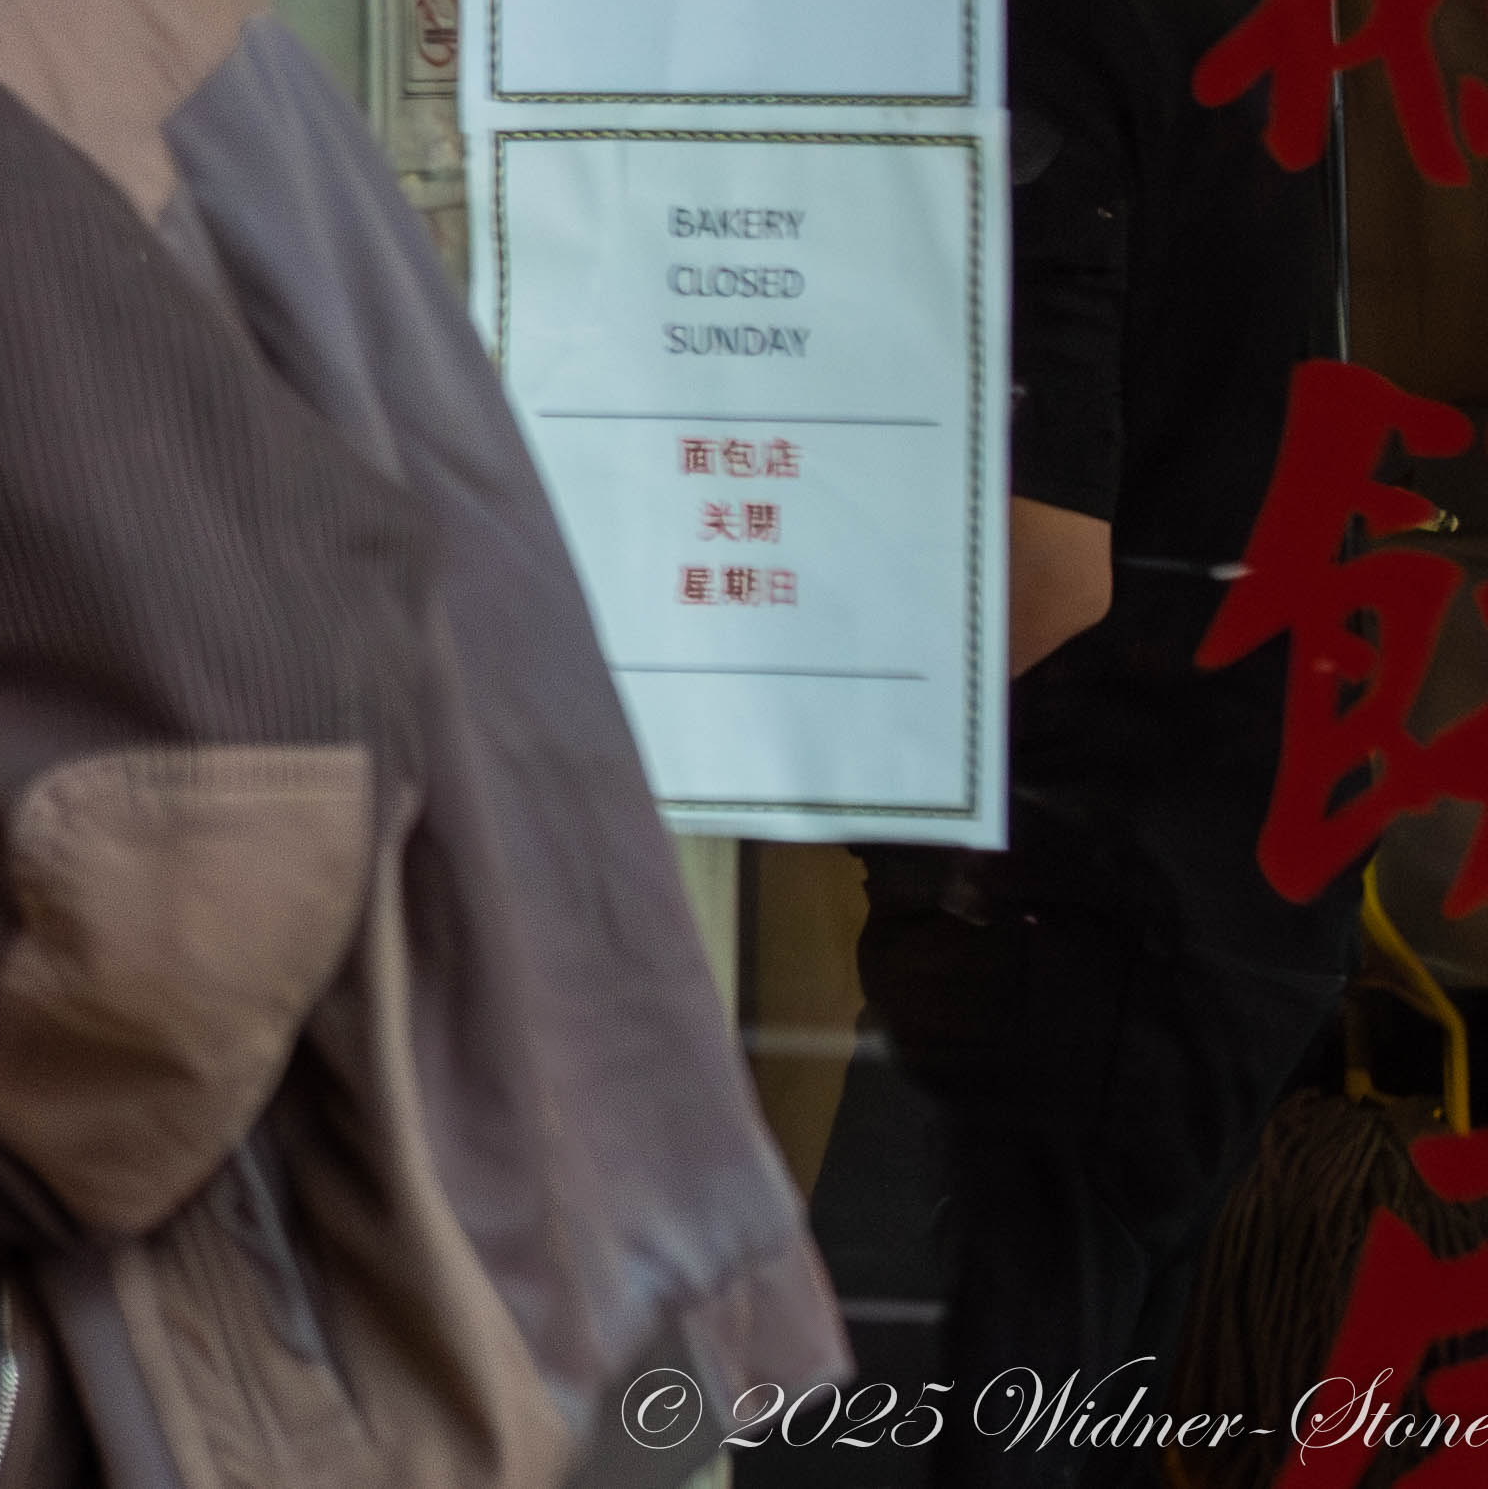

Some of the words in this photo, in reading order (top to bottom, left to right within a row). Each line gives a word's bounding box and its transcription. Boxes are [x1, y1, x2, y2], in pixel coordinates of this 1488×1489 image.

[667, 207, 806, 241] BAKERY
[667, 266, 805, 300] CLOSED
[663, 323, 811, 358] SUNDAY
[679, 436, 803, 479] 面包店
[679, 565, 798, 607] 星期日
